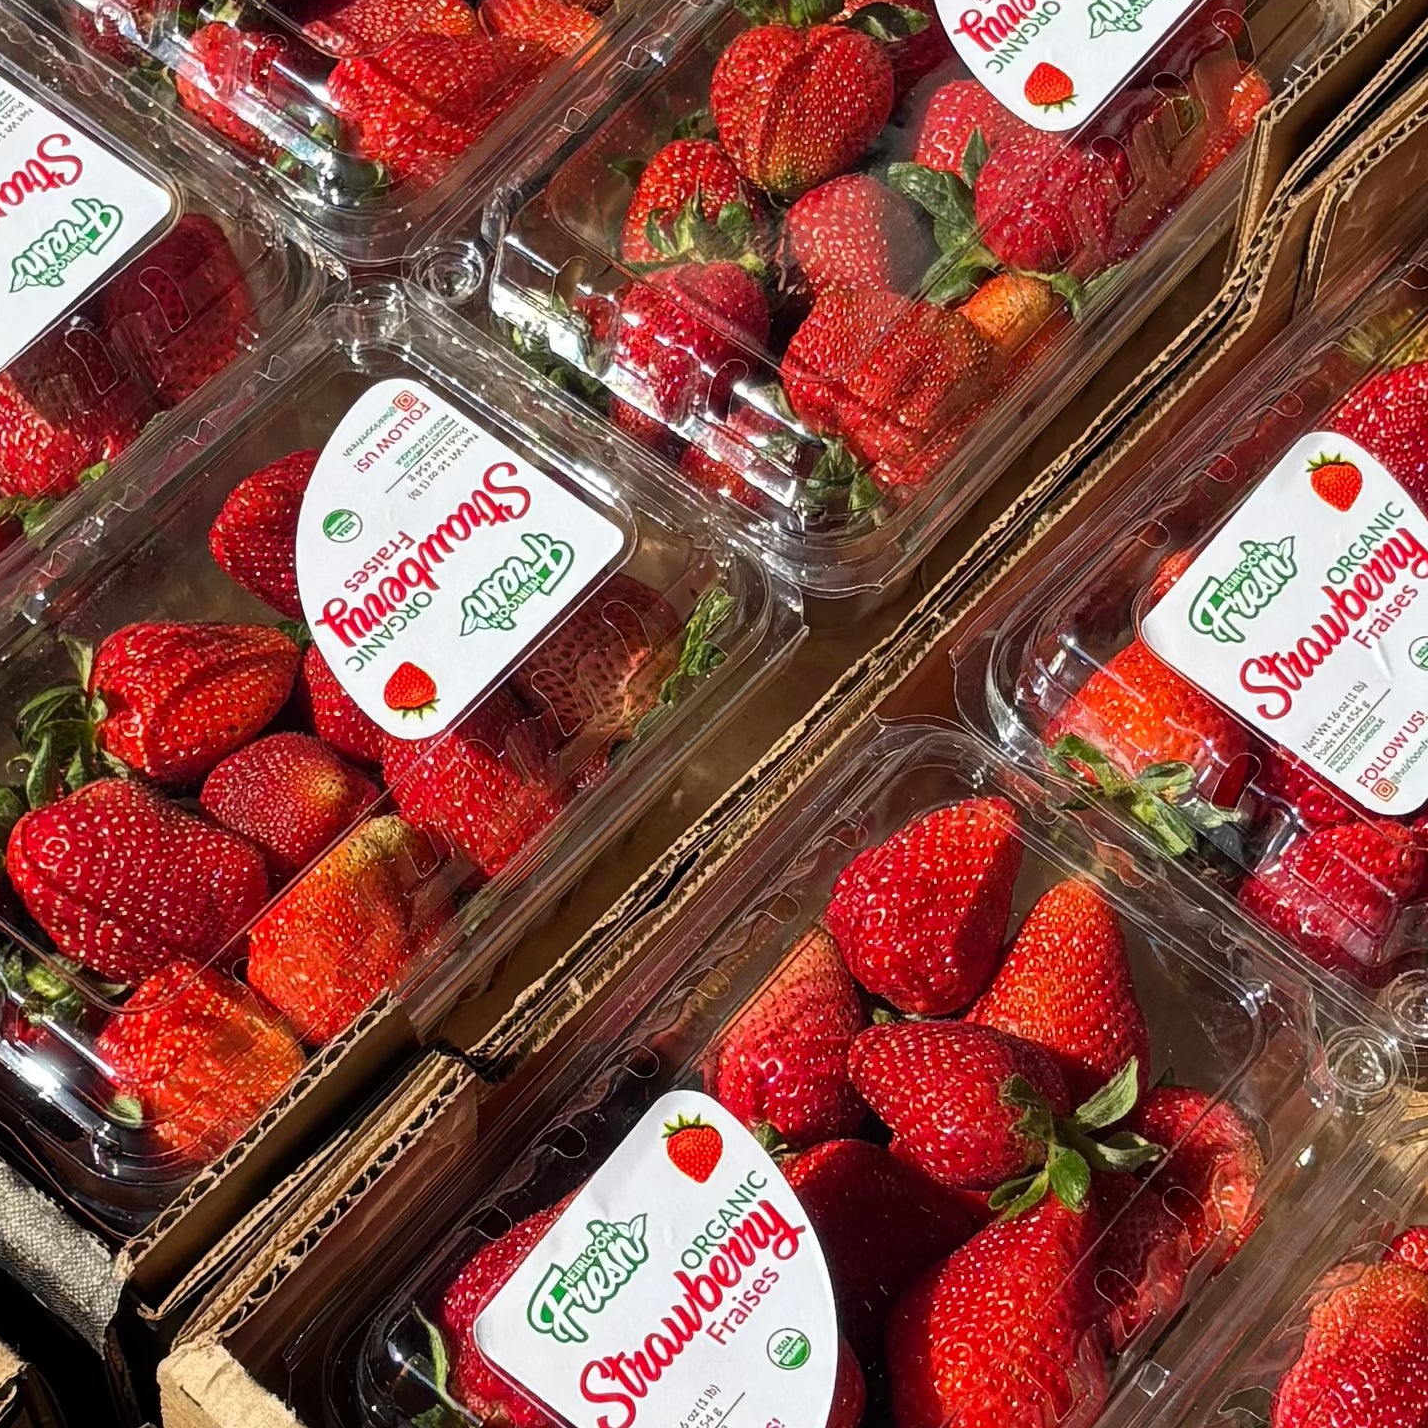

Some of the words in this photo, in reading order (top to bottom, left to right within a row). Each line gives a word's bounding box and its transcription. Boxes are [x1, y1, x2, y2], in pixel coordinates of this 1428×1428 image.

[985, 0, 1061, 74] ORGANIC
[10, 197, 121, 289] Fresh
[351, 450, 381, 475] US!
[374, 401, 432, 455] FOLLOW
[315, 462, 532, 647] Strawberry
[344, 529, 416, 592] Fraises
[460, 531, 573, 632] Fresh
[1327, 501, 1405, 583] ORGANIC
[1189, 539, 1298, 644] Fresh
[1352, 584, 1418, 650] Fraises
[344, 592, 432, 673] ORGANIC
[1355, 730, 1410, 789] FOLLOW
[1401, 709, 1428, 735] US!
[680, 1169, 768, 1268] ORGANIC
[528, 1219, 650, 1345] Fresh
[705, 1267, 779, 1346] Fraises
